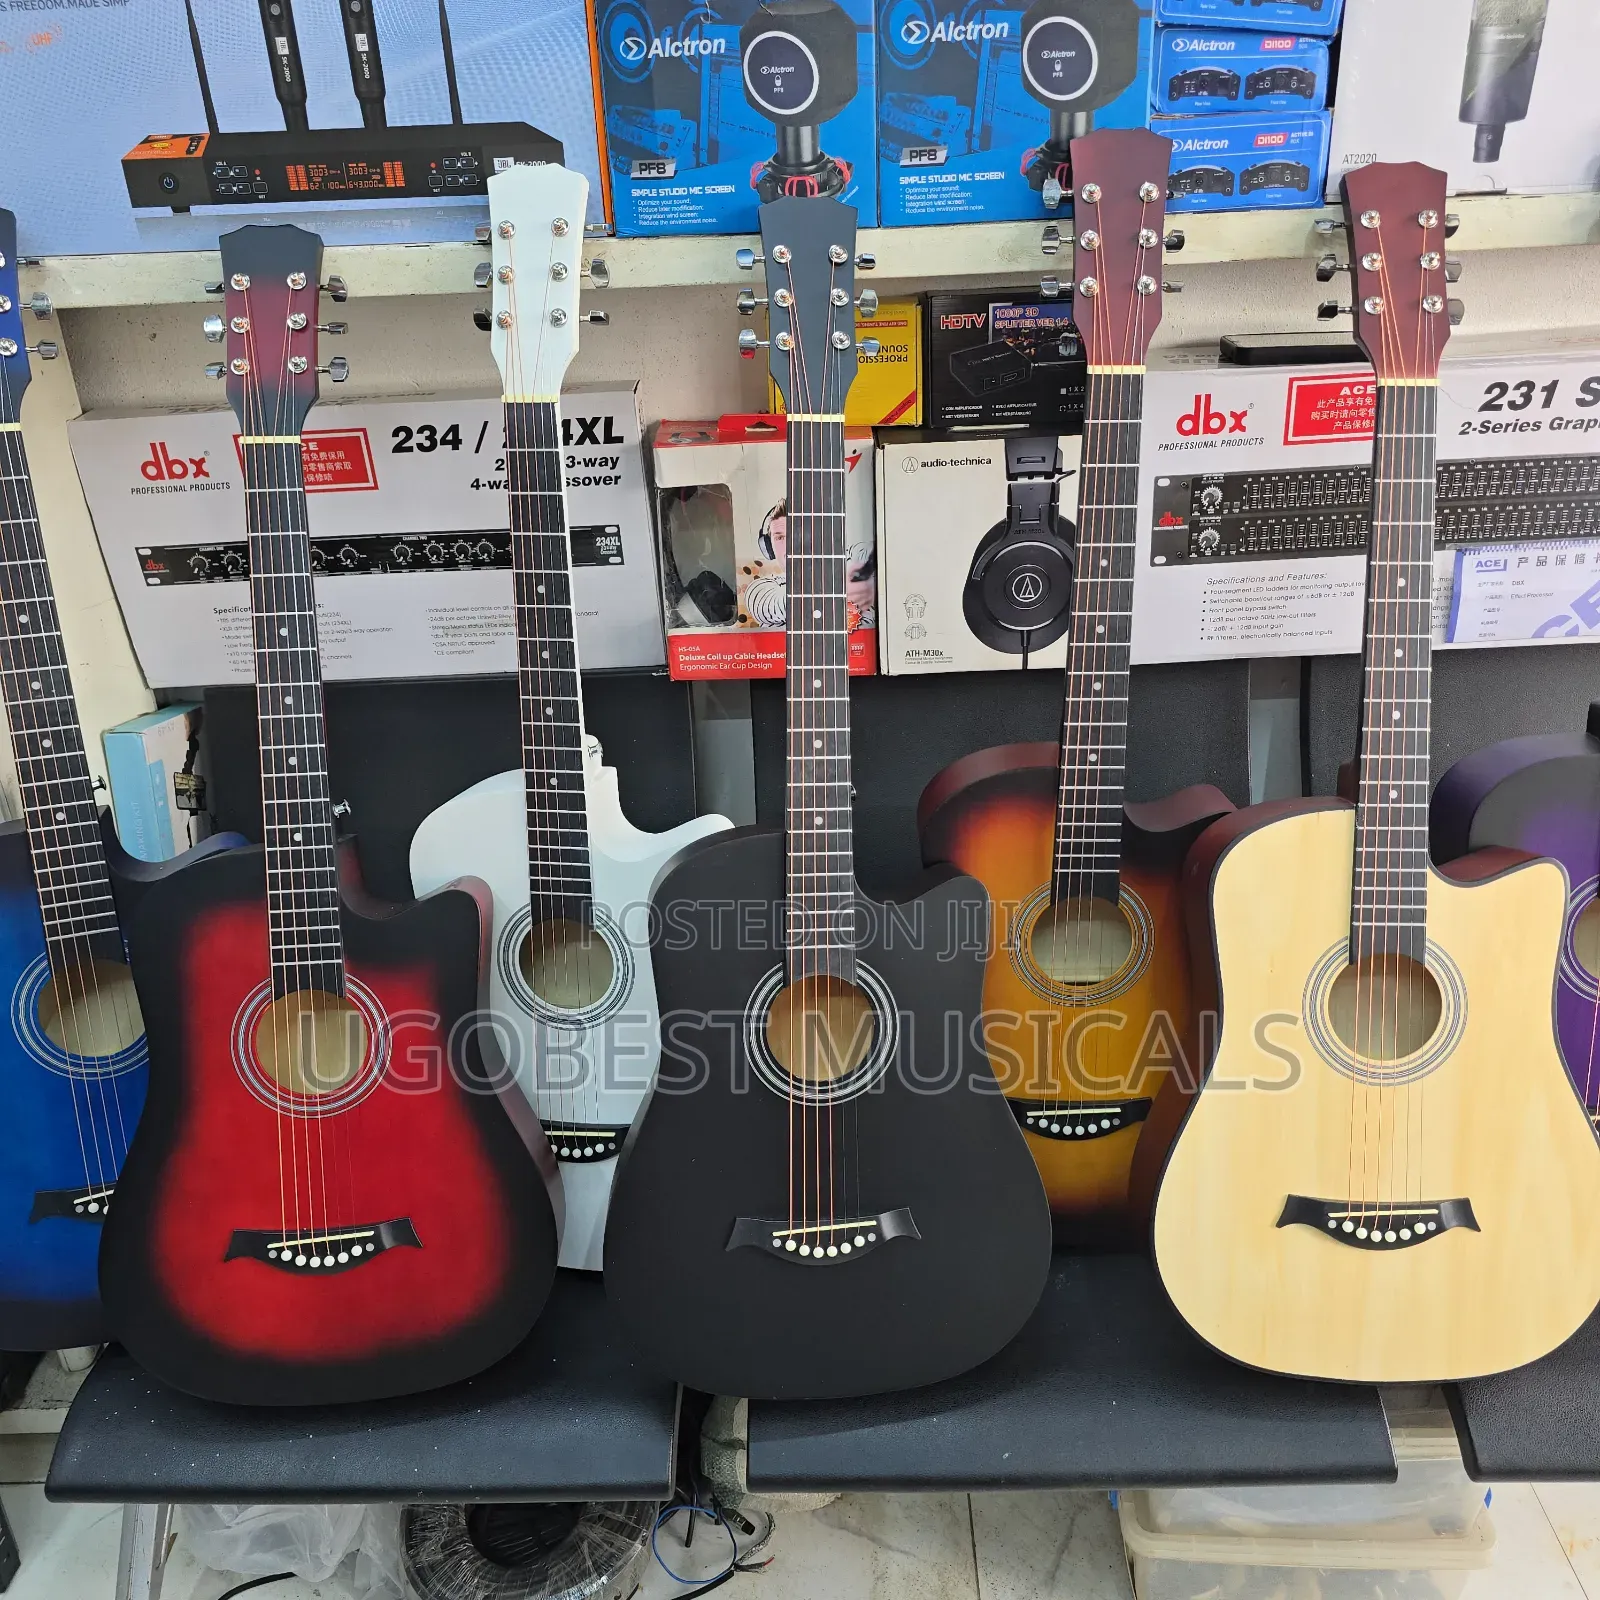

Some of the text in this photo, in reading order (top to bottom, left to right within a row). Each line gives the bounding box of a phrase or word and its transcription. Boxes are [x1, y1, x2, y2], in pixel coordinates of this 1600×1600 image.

[930, 20, 1009, 43] Alctron
[648, 37, 726, 60] Alctron
[1189, 39, 1236, 51] Alctron
[1264, 40, 1291, 48] DI100
[1050, 50, 1076, 58] Alctron
[281, 56, 291, 82] SK-2000
[361, 53, 370, 79] SK-2000
[769, 65, 795, 74] Alctron
[1183, 139, 1229, 151] Alctron
[1257, 135, 1284, 145] DI100
[909, 149, 937, 162] PF8
[1342, 153, 1377, 164] AT2020
[309, 168, 328, 176] 3003
[349, 167, 368, 175] 3003
[639, 162, 667, 175] PF8
[899, 171, 1005, 185] SIMPLE STUDIO MIC SCREEN
[631, 185, 735, 197] SIMPLE STUDIO MIC SCREEN
[994, 306, 1040, 319] 1080P 3D
[940, 312, 987, 330] HDTV
[994, 319, 1036, 329] SPLITTER
[1036, 318, 1055, 327] VER
[879, 344, 909, 353] SOUN
[858, 354, 908, 364] PROFESSIO
[1339, 384, 1376, 395] ACE
[1477, 379, 1560, 413] 231
[1316, 396, 1376, 409] 此产品享有免
[1175, 393, 1248, 437] dbx
[1310, 407, 1376, 421] 购买时请向零售
[1458, 416, 1600, 436] 2-Series Grap
[391, 423, 463, 453] 234
[474, 420, 489, 454] /
[301, 442, 319, 451] CE
[1158, 437, 1265, 451] PROFESSIONAL PRODUCTS
[140, 442, 210, 481] dbx
[565, 455, 620, 470] 3-way
[920, 456, 992, 468] audio-technica
[131, 482, 231, 495] PROFESSIONAL PRODUCTS
[470, 477, 510, 490] 4-wa
[1158, 511, 1184, 526] dbx
[595, 536, 620, 546] 234XL
[145, 559, 165, 570] dbx
[1475, 559, 1502, 569] ACE
[1206, 572, 1328, 586] Specifications and Features:
[213, 605, 252, 615] Specificat
[679, 651, 787, 662] Deluxe Coil up Cable Headset
[904, 649, 944, 657] ATH-M30x
[679, 661, 773, 671] Ergonomic Ear Cup Design
